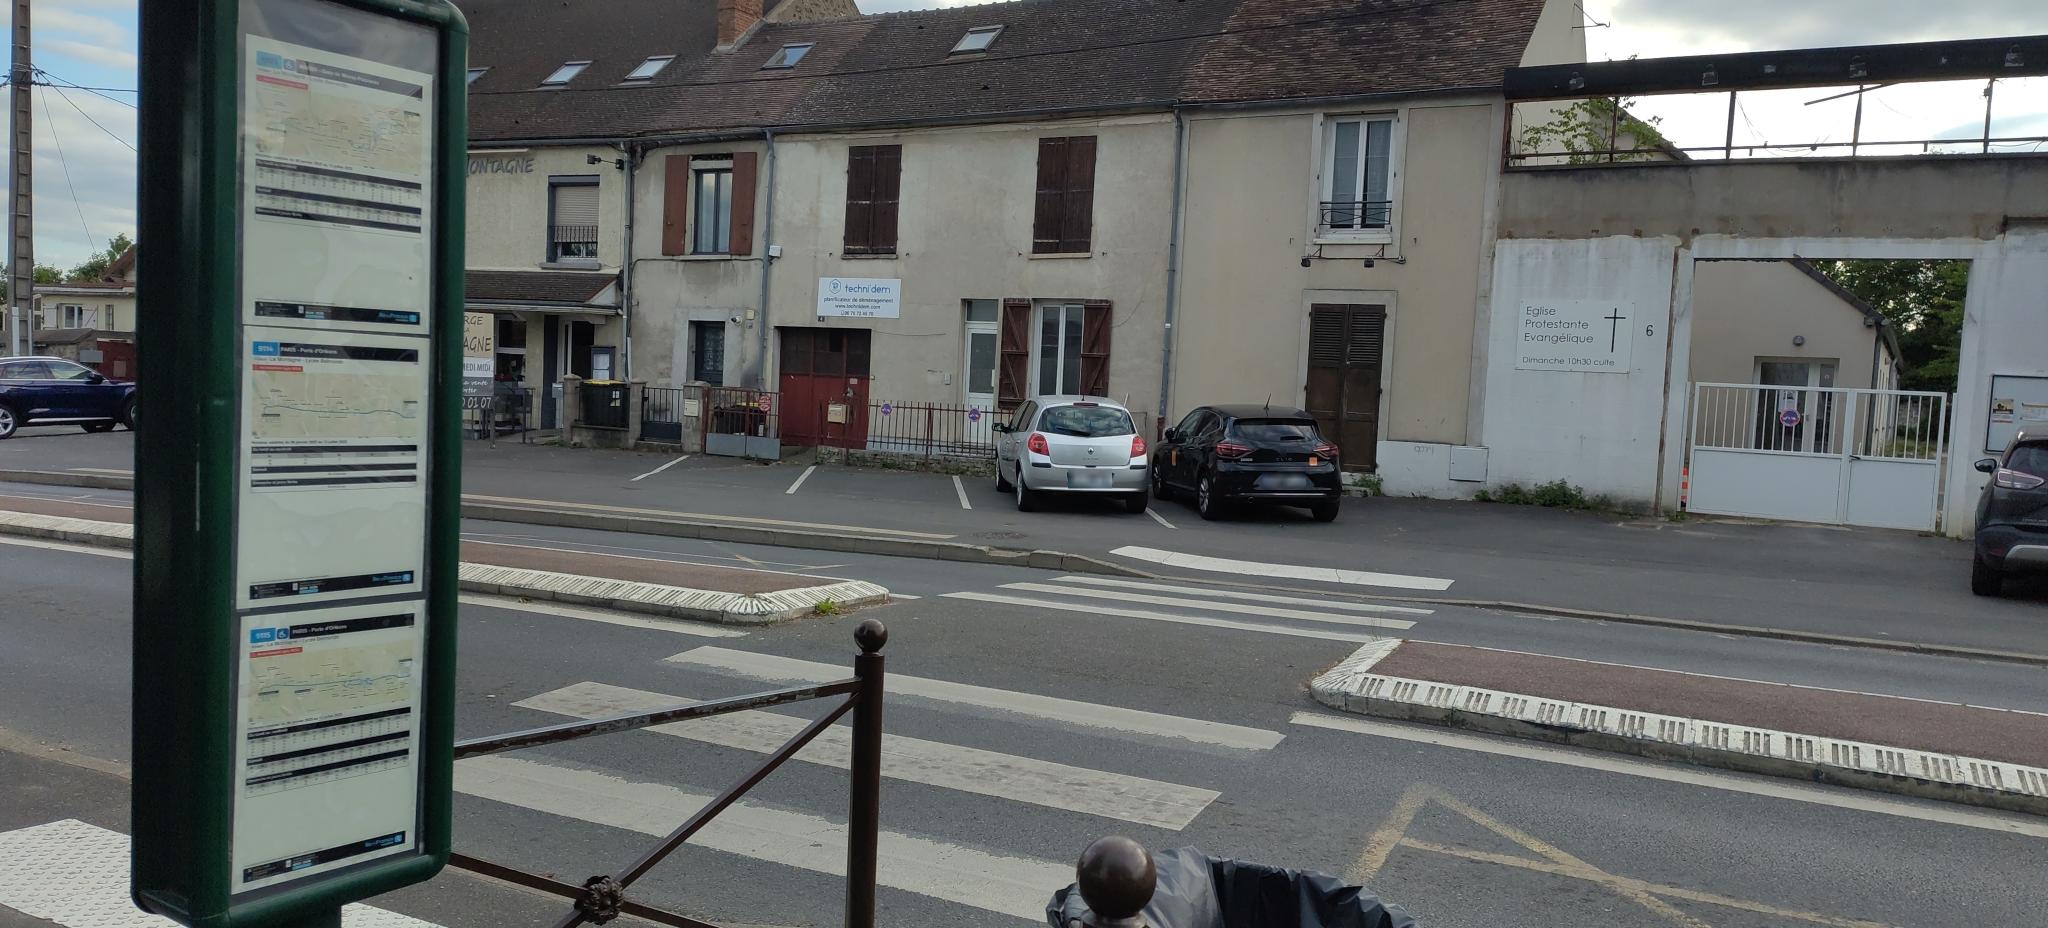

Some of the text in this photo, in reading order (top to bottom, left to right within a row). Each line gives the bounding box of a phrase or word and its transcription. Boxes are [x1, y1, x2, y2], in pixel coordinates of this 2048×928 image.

[1526, 306, 1557, 318] Eglise
[1525, 319, 1590, 330] Protestante
[1646, 324, 1654, 337] 6
[1524, 332, 1594, 345] Evangélique
[1522, 356, 1615, 367] Dimanche 10h30 culte
[467, 396, 479, 409] 01
[480, 397, 492, 409] 07
